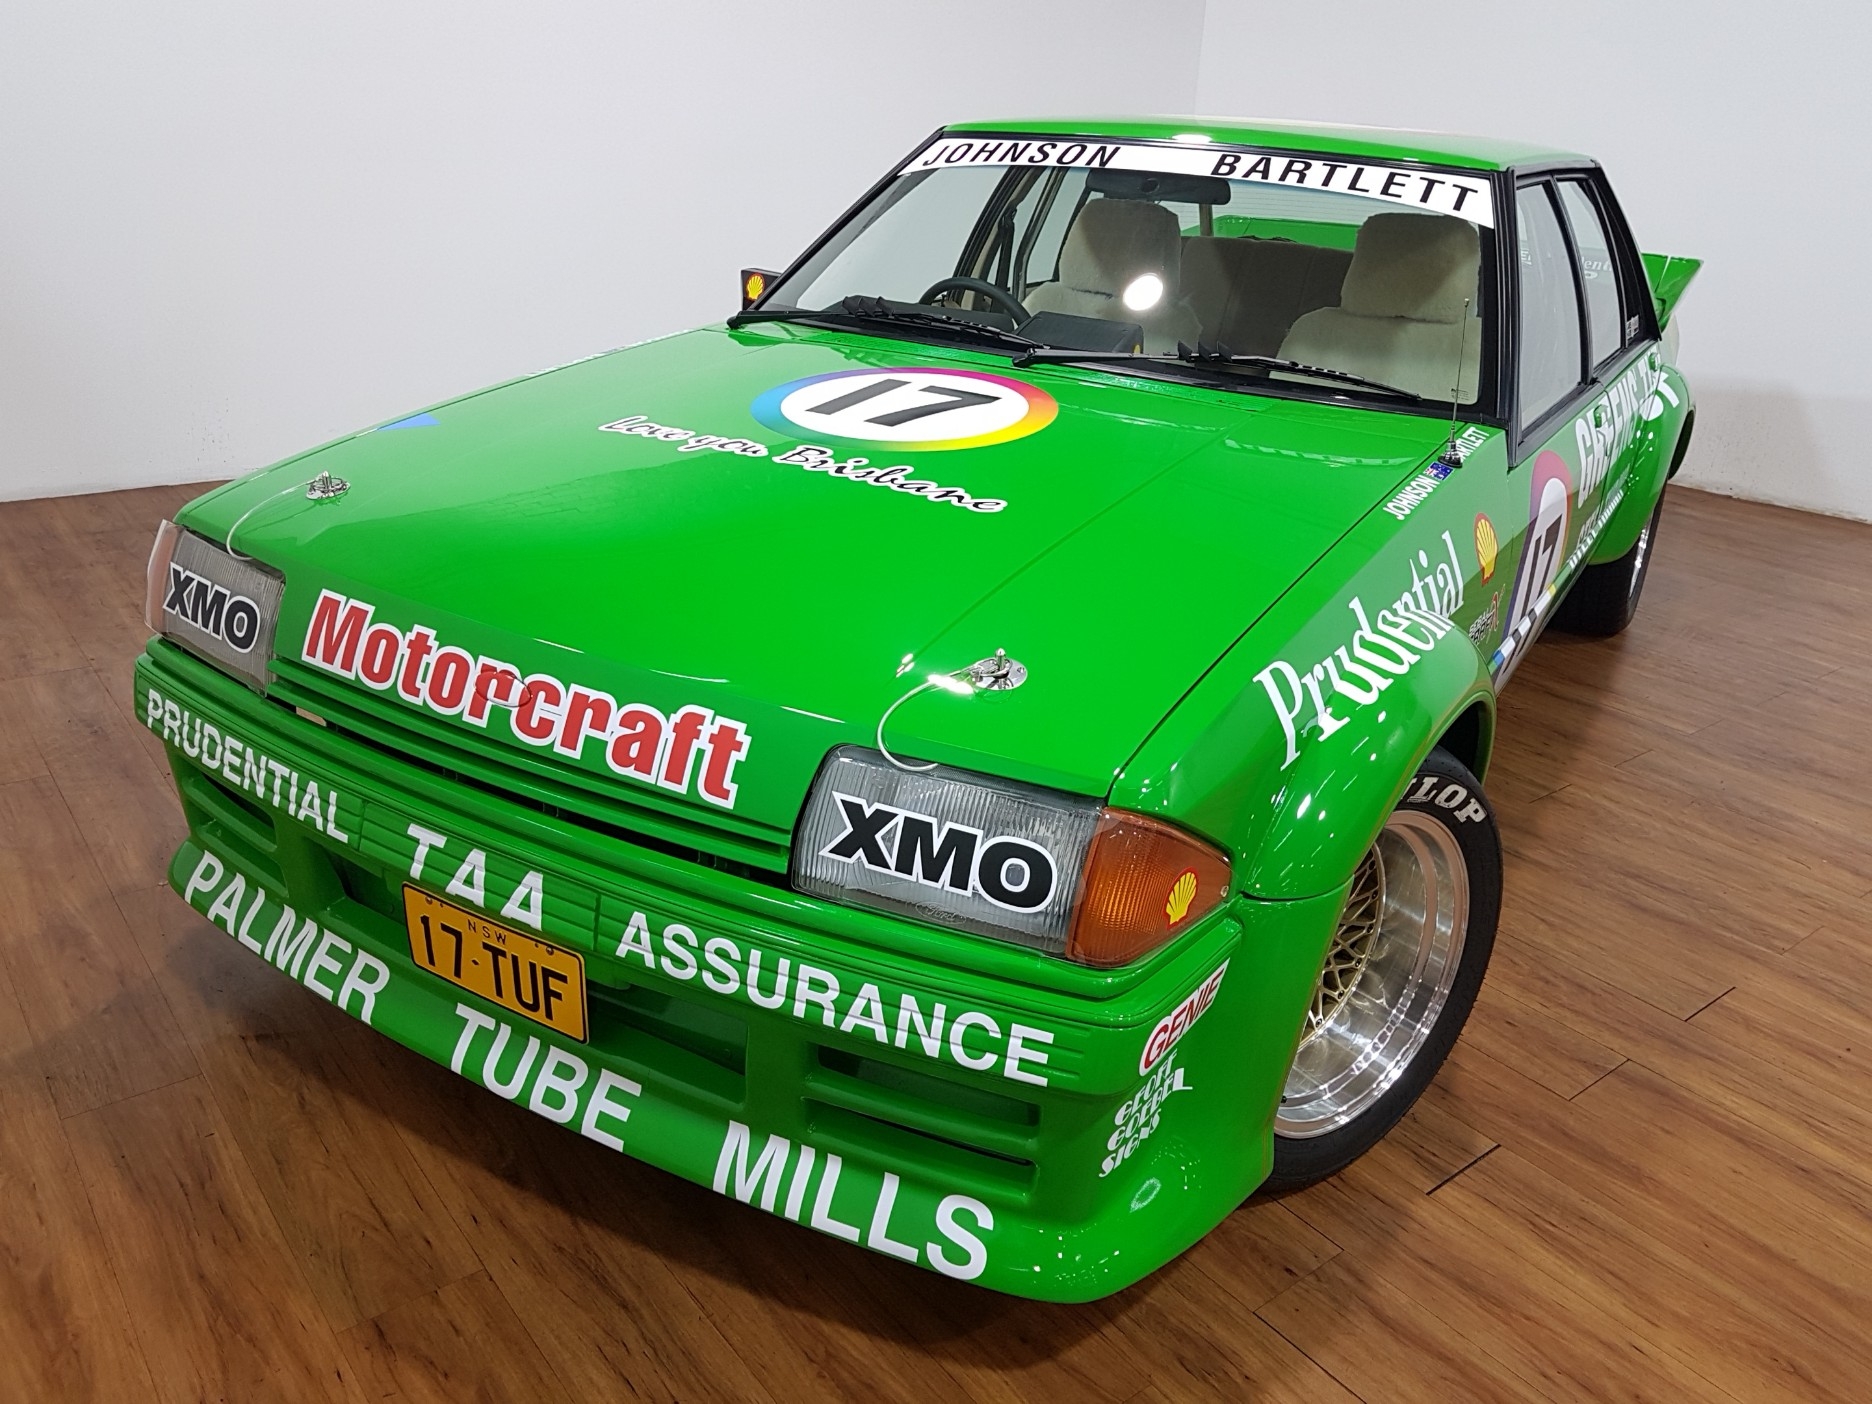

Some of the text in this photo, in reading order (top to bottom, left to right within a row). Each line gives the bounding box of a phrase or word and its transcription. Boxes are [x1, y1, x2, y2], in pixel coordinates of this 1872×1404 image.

[922, 142, 1478, 212] JOHNSON BARTLETT
[805, 378, 1003, 427] 17
[599, 415, 1008, 513] Love you Brisbane
[1382, 474, 1440, 521] JOHNSON
[163, 562, 261, 654] XMO
[1252, 530, 1464, 772] Prudential
[301, 588, 752, 809] Motorcraft
[147, 689, 349, 844] PRUDENTIAL
[615, 911, 1055, 1087] ASSURANCE
[818, 790, 1058, 914] XMO
[467, 918, 507, 946] NSW
[1143, 966, 1226, 1061] GENIE
[184, 850, 995, 1281] PALMER TUBE MILLS
[1106, 1067, 1194, 1152] GOEBEL
[1114, 1048, 1178, 1127] GEOFF
[1098, 1108, 1162, 1178] SIGNS
